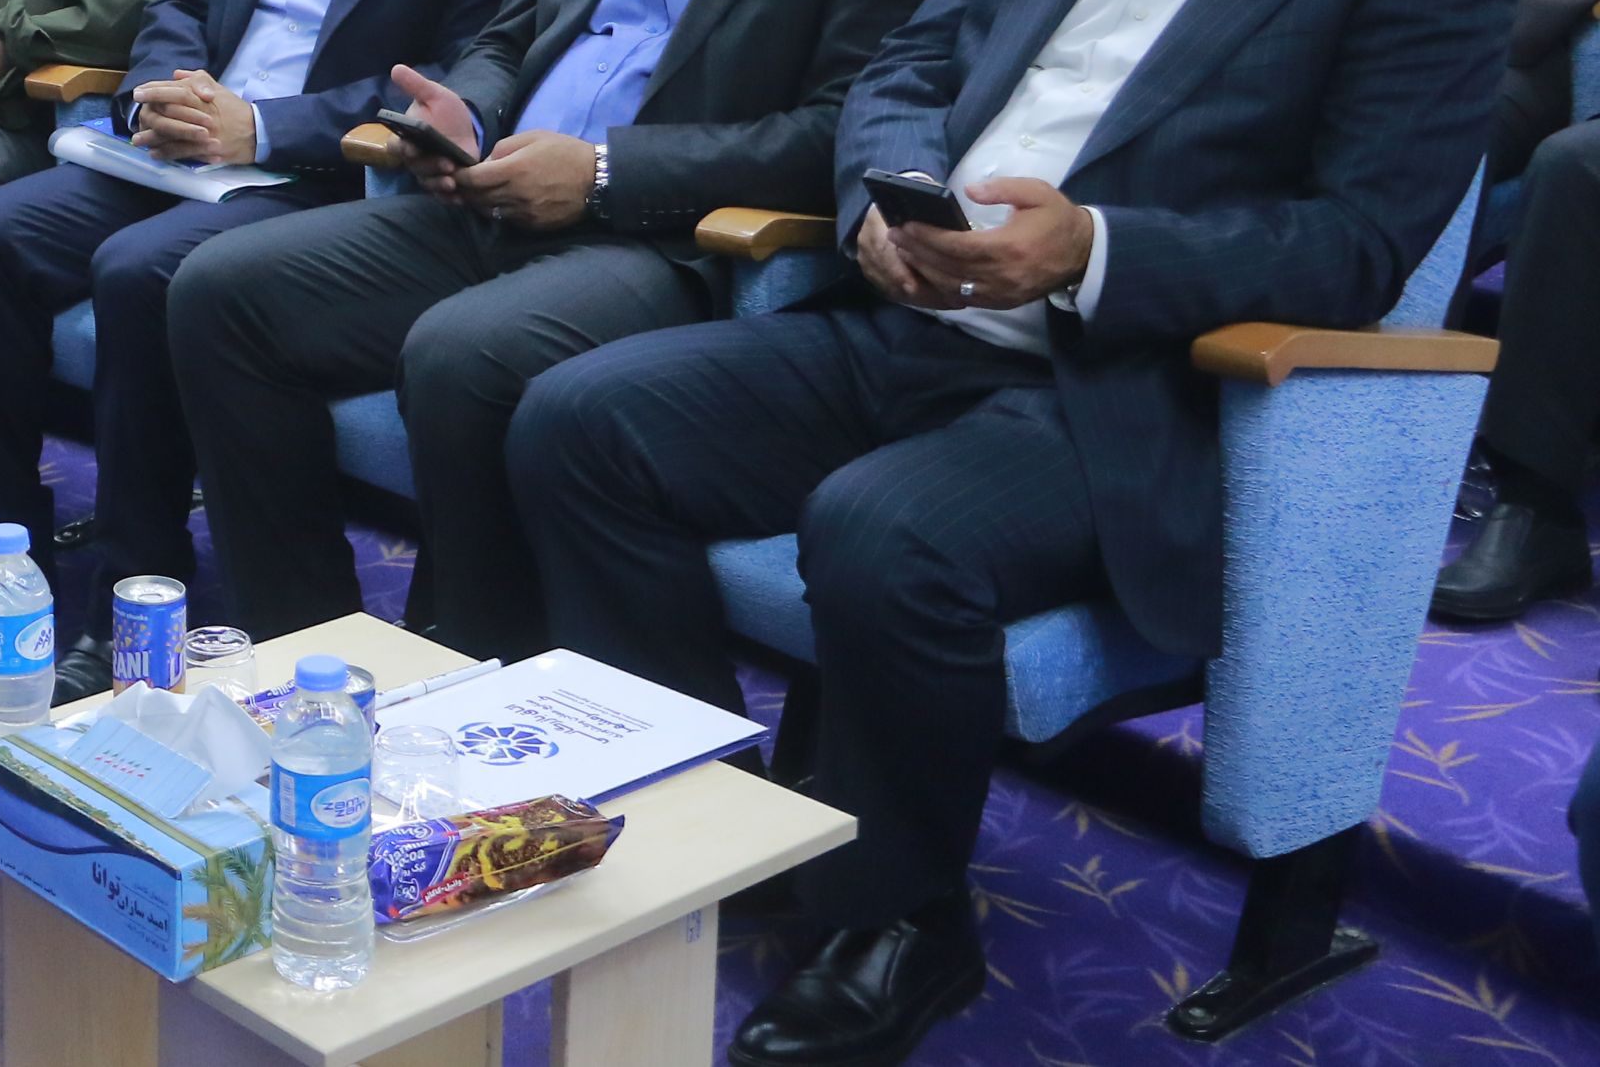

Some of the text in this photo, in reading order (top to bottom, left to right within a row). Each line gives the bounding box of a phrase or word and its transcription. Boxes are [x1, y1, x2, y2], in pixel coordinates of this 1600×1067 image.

[503, 703, 610, 745] اتاق بازرگانی
[538, 696, 641, 734] خرمشهر
[91, 860, 121, 902] توانا
